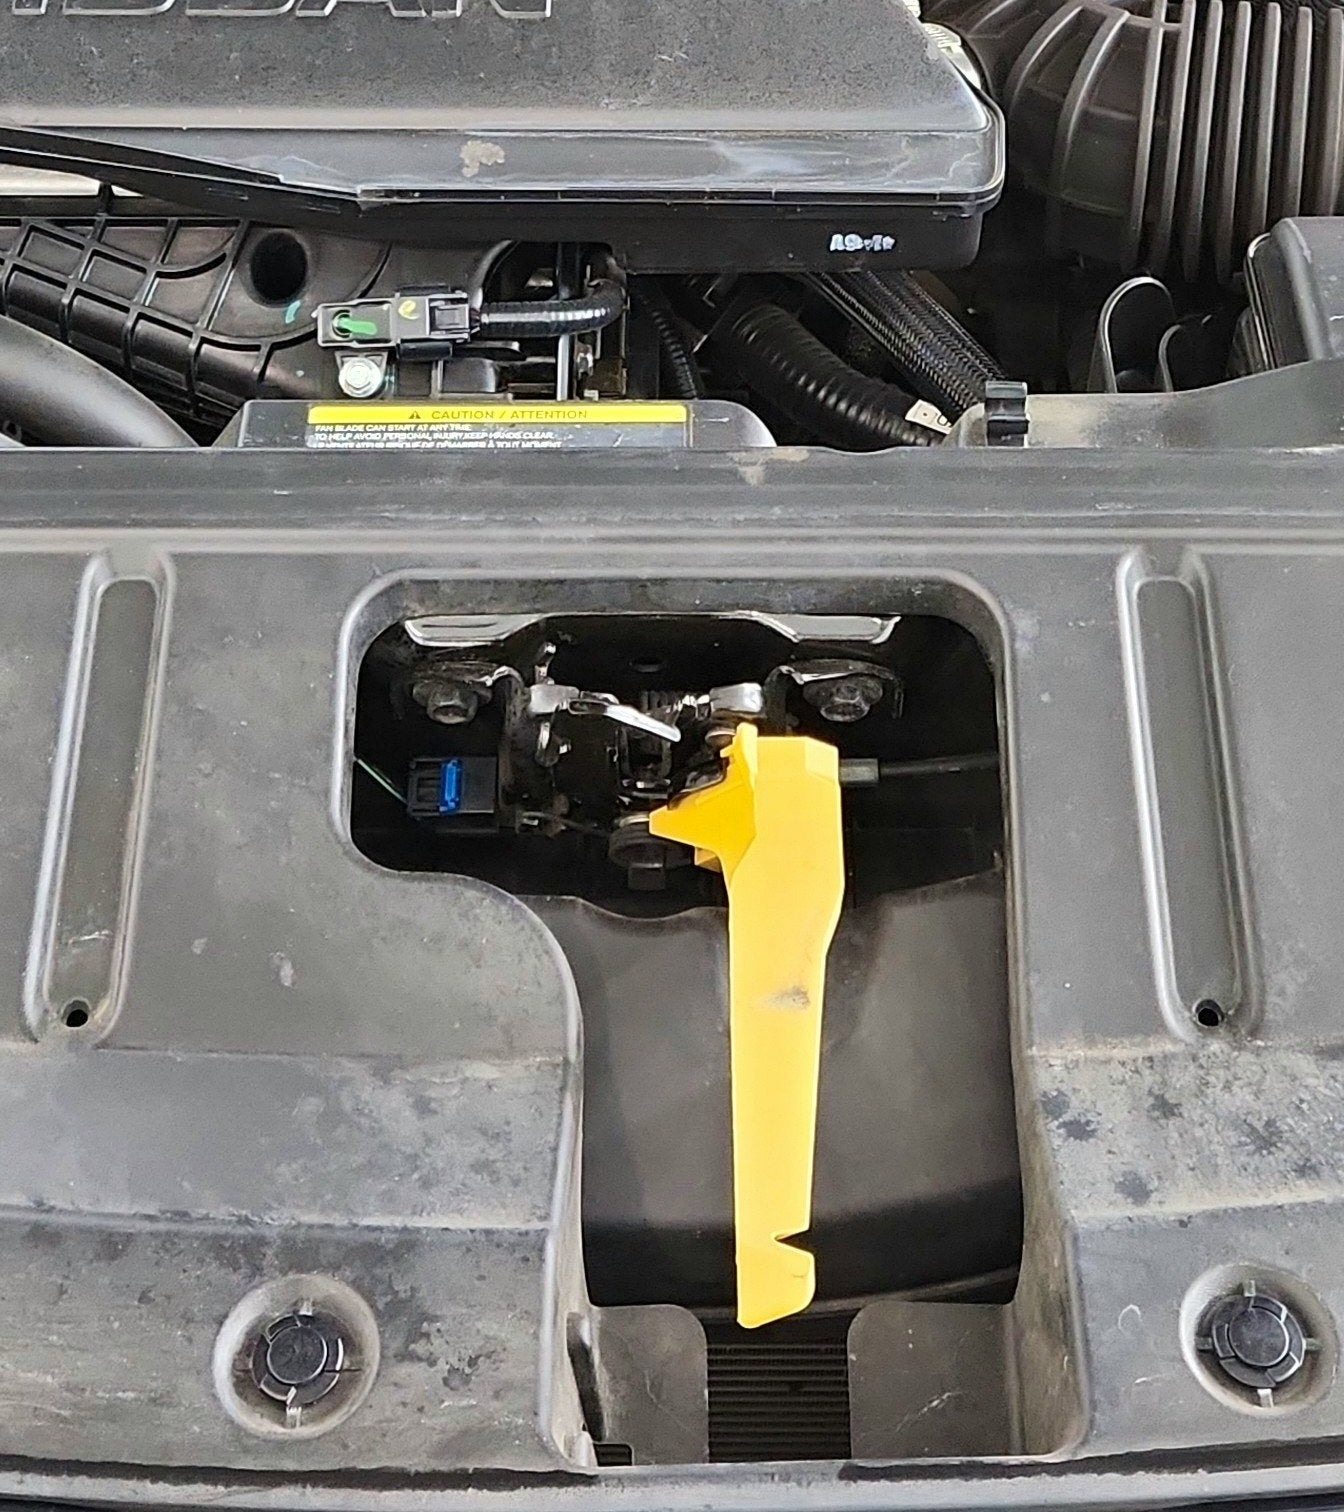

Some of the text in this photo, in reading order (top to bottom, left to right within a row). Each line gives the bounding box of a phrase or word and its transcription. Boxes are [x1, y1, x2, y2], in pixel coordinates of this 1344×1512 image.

[431, 411, 495, 420] CAUTION
[510, 411, 587, 420] ATTENTION
[366, 424, 387, 432] CAN
[387, 424, 416, 432] START
[416, 424, 429, 432] AT
[429, 424, 449, 432] ANY
[315, 432, 327, 441] TO
[328, 432, 353, 441] HELP
[353, 432, 382, 440] AVOID
